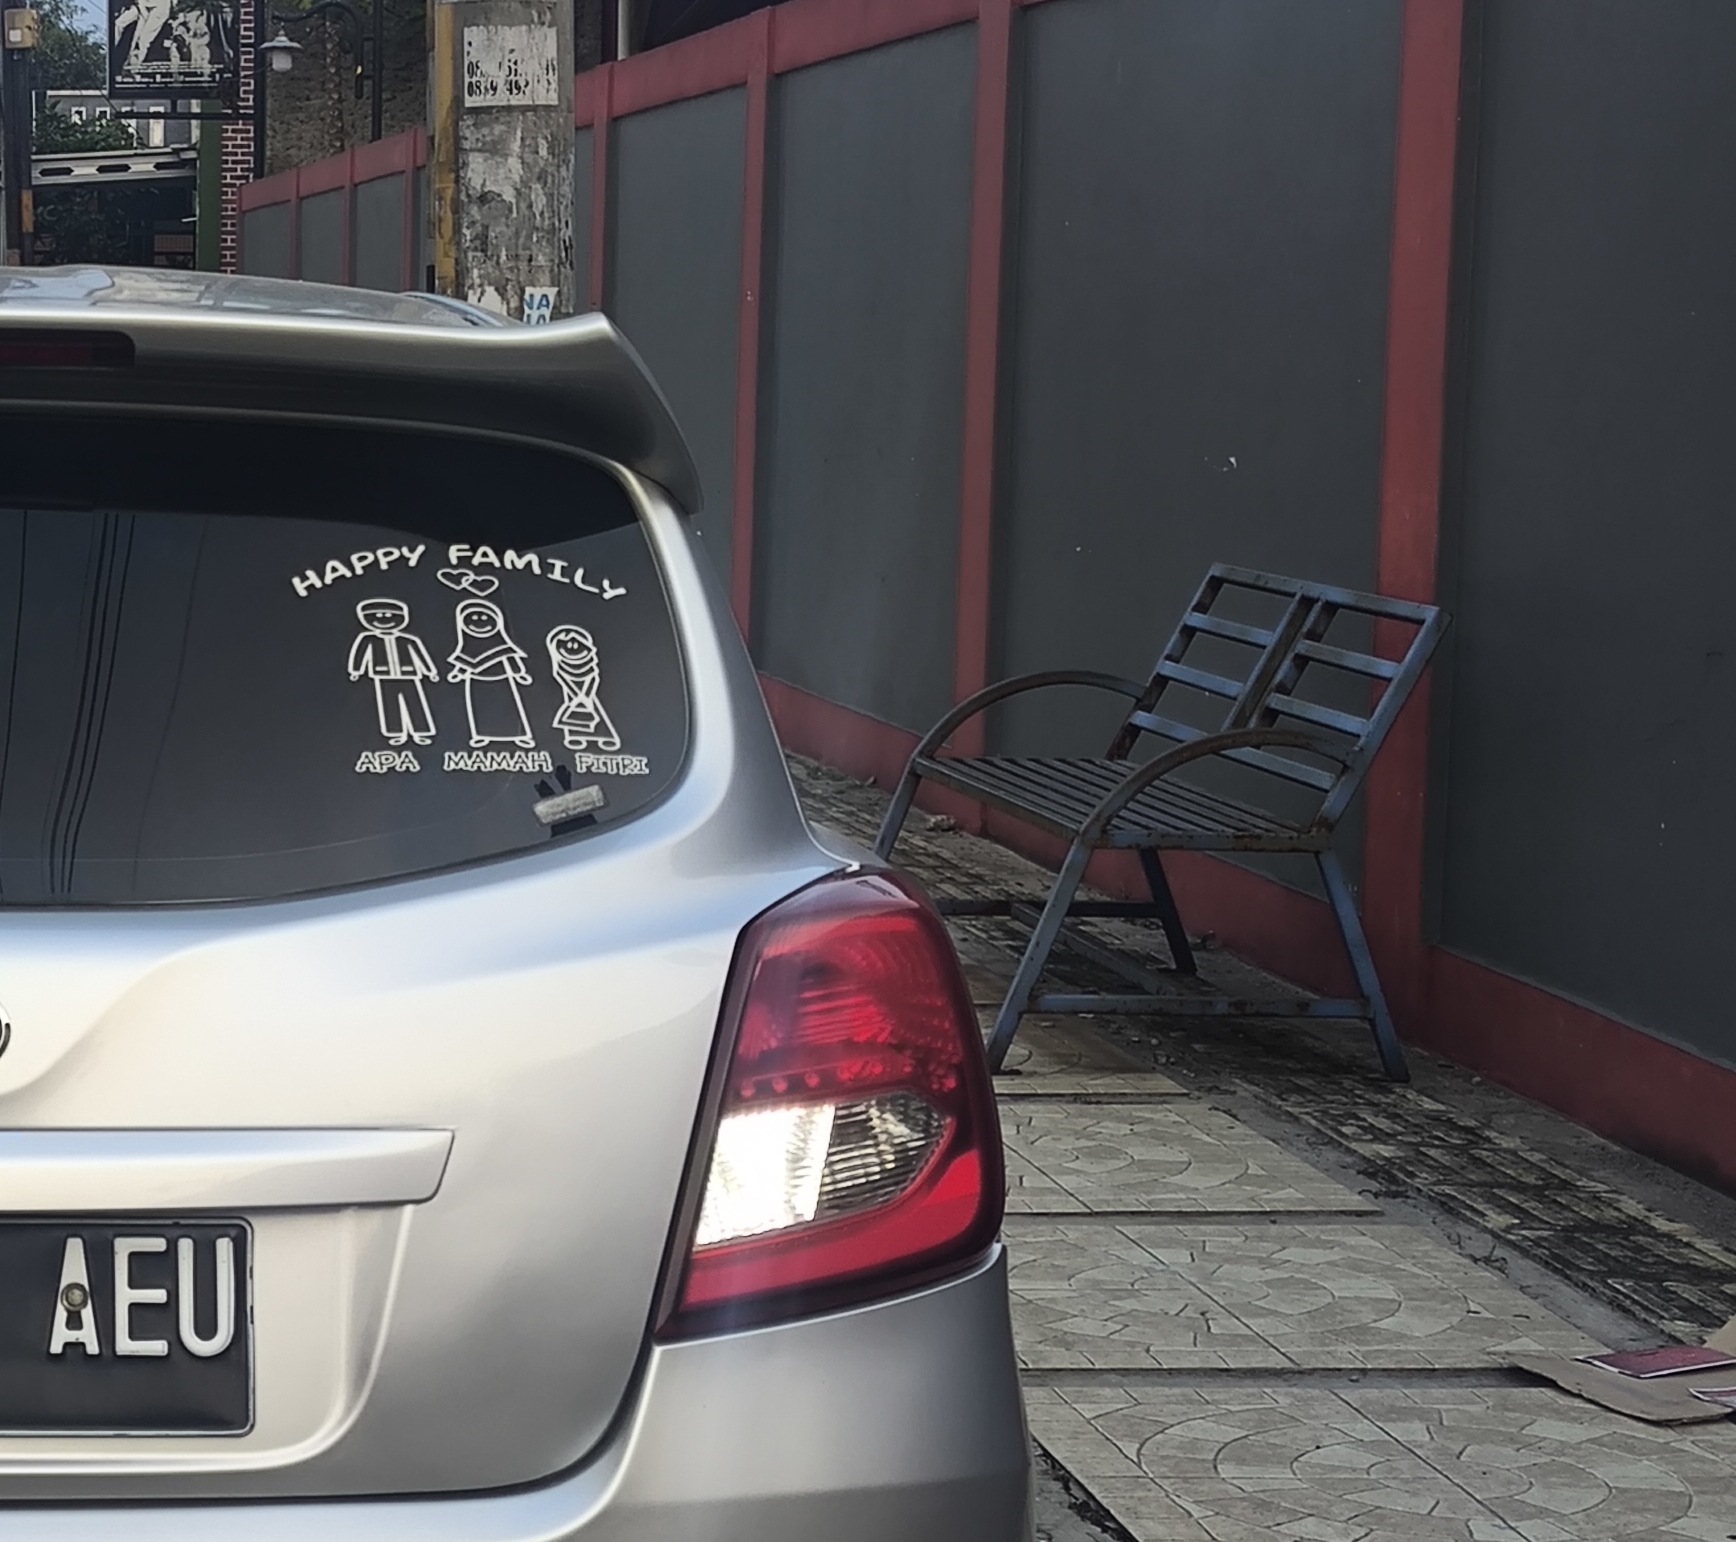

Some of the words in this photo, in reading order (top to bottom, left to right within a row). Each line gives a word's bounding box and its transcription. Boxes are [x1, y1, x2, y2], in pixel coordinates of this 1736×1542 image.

[291, 544, 425, 597] HAPPY
[448, 544, 627, 600] FAMILY
[355, 751, 420, 773] APA
[443, 751, 553, 773] MAMAH
[575, 752, 649, 775] FITRI
[49, 1236, 235, 1357] AEU
